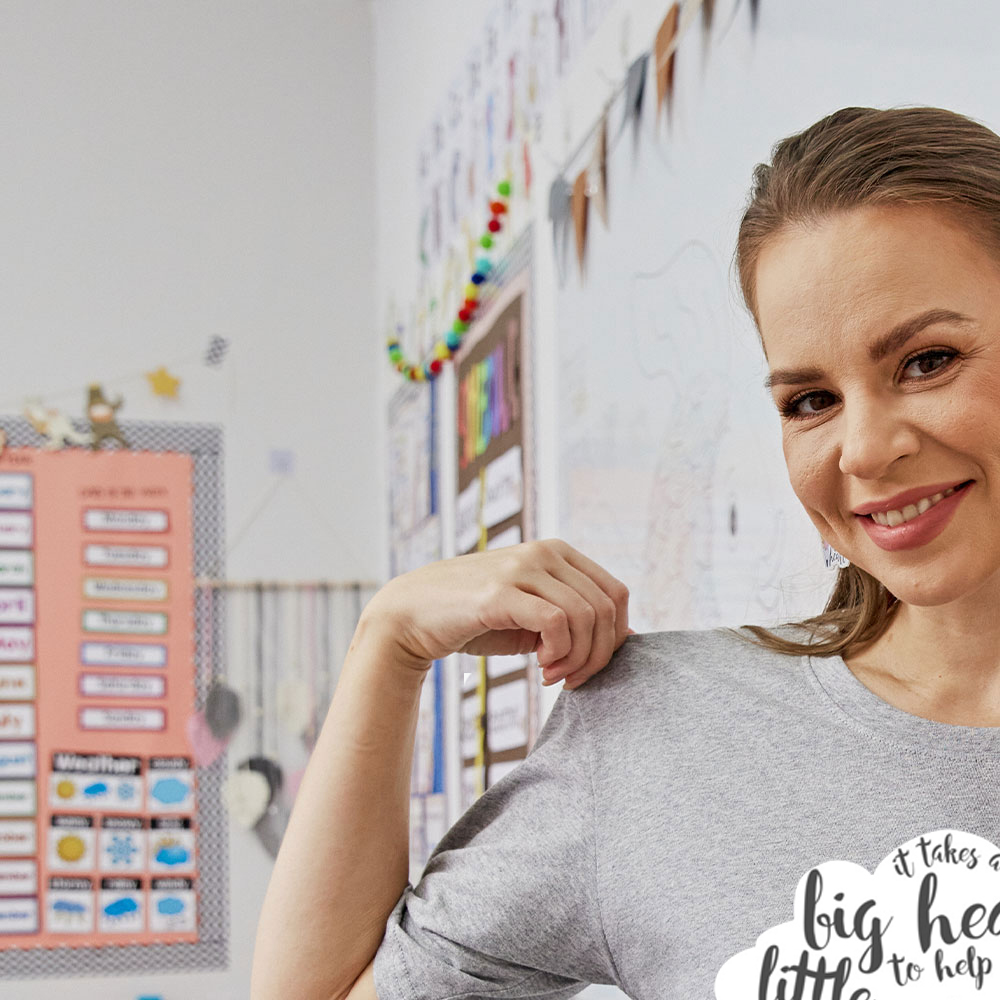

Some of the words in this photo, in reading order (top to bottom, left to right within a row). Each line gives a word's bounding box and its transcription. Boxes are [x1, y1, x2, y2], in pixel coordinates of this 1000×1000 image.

[893, 848, 915, 878] it
[916, 833, 980, 869] takes
[803, 869, 893, 974] big
[887, 952, 924, 986] to
[935, 946, 992, 989] help
